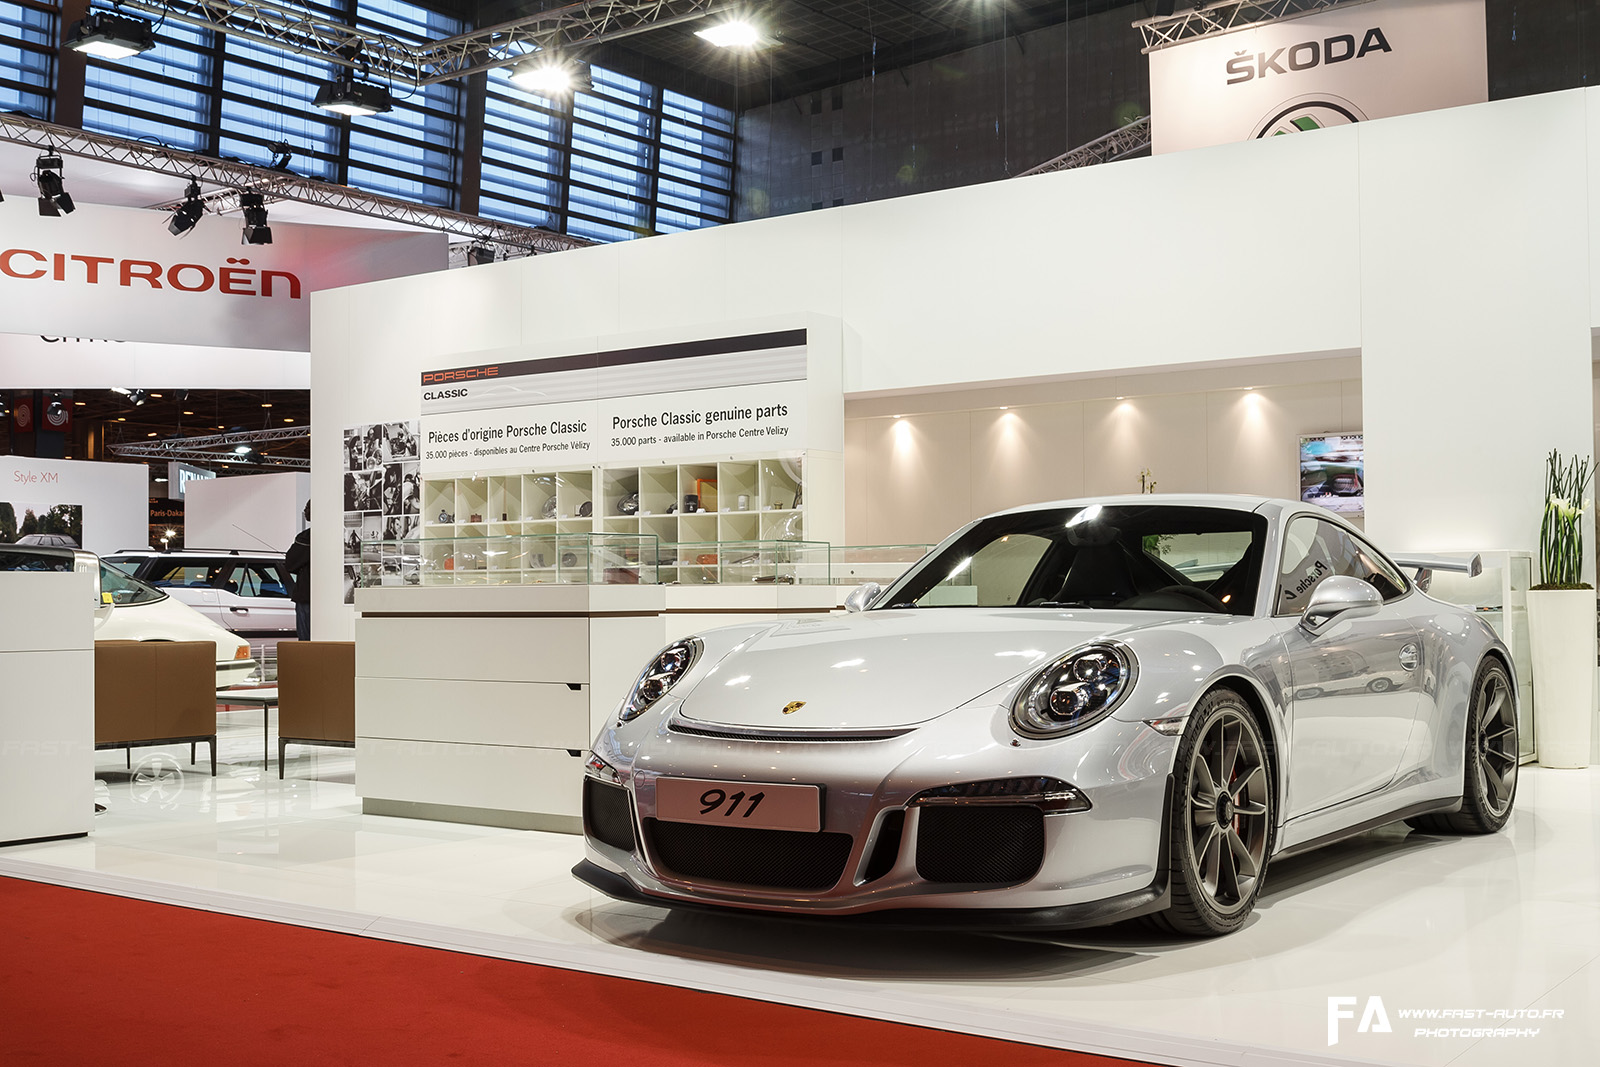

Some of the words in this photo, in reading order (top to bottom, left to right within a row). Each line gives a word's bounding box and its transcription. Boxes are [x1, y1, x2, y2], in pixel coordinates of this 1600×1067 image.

[1226, 27, 1392, 85] ŠKODA
[423, 366, 498, 383] PORSCHE
[423, 388, 468, 400] CLASSIC
[612, 414, 657, 430] Porsche
[661, 410, 701, 426] Classic
[705, 406, 752, 425] genuine
[756, 403, 788, 421] parts
[428, 430, 459, 444] Pièces
[462, 427, 503, 442] d'origine
[506, 423, 547, 438] Porsche
[550, 419, 587, 434] Classic
[611, 436, 636, 447] 35.000
[638, 435, 657, 447] parts
[663, 432, 696, 444] available
[697, 431, 705, 441] in
[706, 429, 737, 440] Porsche
[739, 427, 764, 438] Centre
[425, 450, 447, 460] 35.000
[448, 449, 468, 460] pièces
[473, 445, 508, 458] disponibles
[519, 443, 541, 454] Centre
[542, 442, 569, 452] Porsche
[570, 440, 591, 451] Vélizy
[13, 470, 37, 485] Style
[40, 472, 59, 484] XM
[150, 509, 184, 517] Paris-Daka
[699, 788, 765, 818] 911
